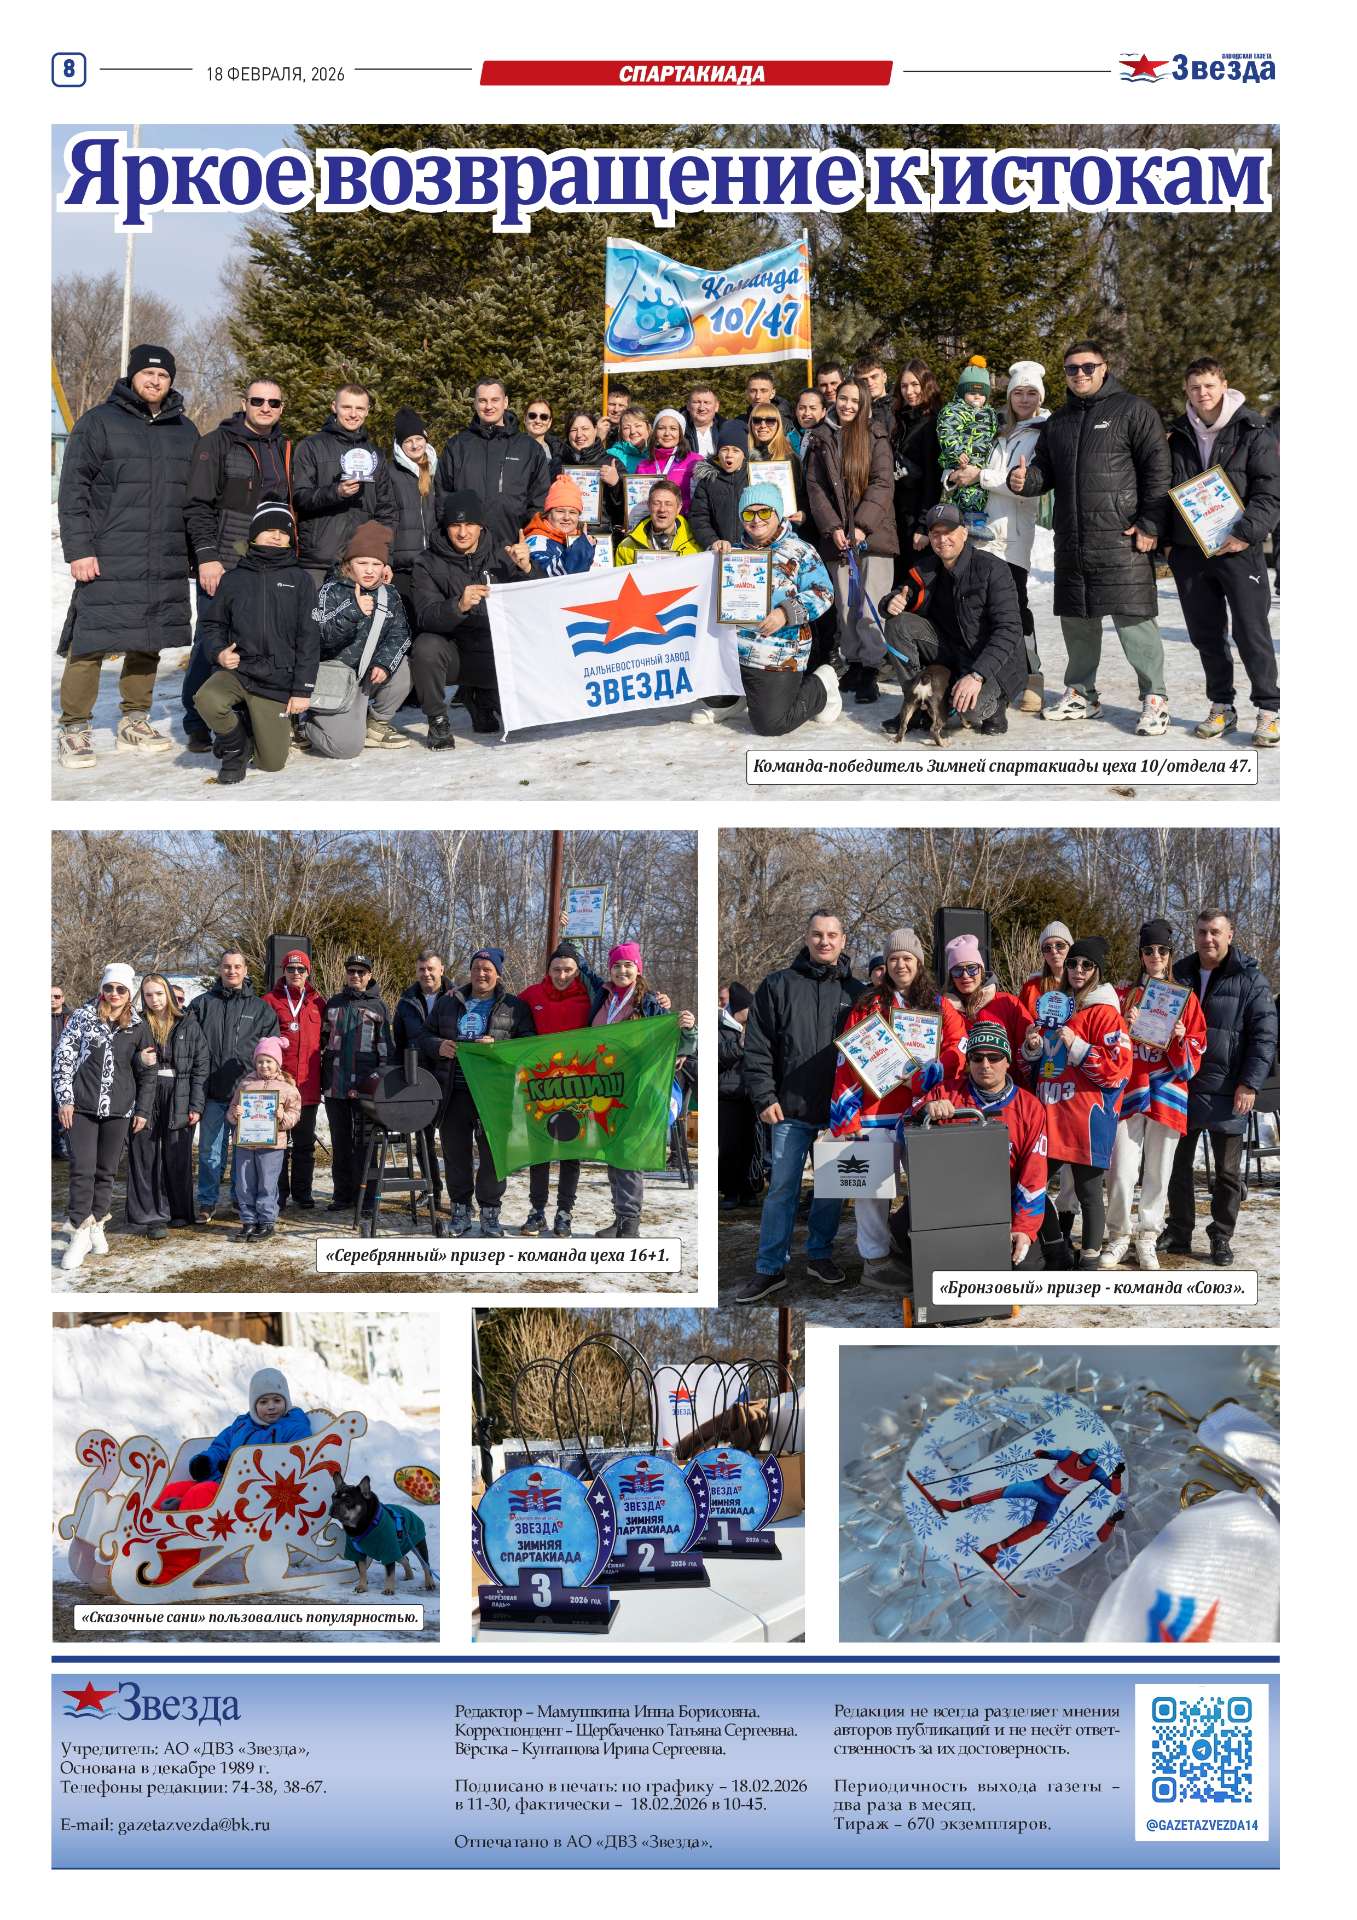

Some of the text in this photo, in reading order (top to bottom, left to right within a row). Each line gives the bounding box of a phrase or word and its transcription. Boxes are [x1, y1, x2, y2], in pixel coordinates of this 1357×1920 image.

[64, 59, 75, 77] 8
[208, 67, 344, 83] 18 ФЕВРАЛЯ, 2026
[620, 66, 765, 85] СПАРТАКИАДА
[1172, 54, 1276, 83] Звезда
[709, 298, 802, 337] 10/47
[584, 651, 690, 678] ДАЛЬНЕВОСТОЧНЫЙ ЗАВОД
[585, 666, 693, 708] ЗВЕЗДА
[527, 1072, 624, 1101] КИПИШ
[840, 1179, 867, 1187] ЗВЕЗДА
[711, 1486, 738, 1496] ВЕЗДА
[624, 1501, 662, 1512] ЗВЕЗДА
[710, 1507, 755, 1515] РТАКИАДА
[711, 1499, 740, 1507] ИМНЯЯ
[514, 1522, 560, 1535] ЗВЕЗДА
[625, 1515, 664, 1526] ЗИМНЯЯ
[616, 1524, 681, 1535] ПАРТАКИАДА
[717, 1521, 733, 1546] 1
[517, 1540, 562, 1551] ЗИМНЯЯ
[500, 1551, 582, 1564] СПАРТАКИАДА
[637, 1543, 656, 1573] 2
[531, 1573, 552, 1608] 3
[569, 1595, 589, 1604] 2026
[118, 1681, 242, 1726] Звезда
[456, 1705, 522, 1721] Редактор
[538, 1705, 630, 1721] Мамушкина
[635, 1705, 674, 1718] Инна
[679, 1705, 760, 1721] Борисовна.
[835, 1704, 1119, 1721] Редакция не всегда разделяет мнения
[456, 1723, 563, 1740] Корреспондент
[576, 1723, 664, 1740] Щербаченко
[667, 1723, 722, 1736] Татьяна
[725, 1723, 797, 1740] Сергеевна.
[834, 1722, 1120, 1741] авторов публикаций и не несёт ответ-
[61, 1741, 309, 1758] Учредитель: АО «ДВЗ «Звезда»,
[455, 1742, 507, 1759] Вёрстка
[604, 1742, 649, 1759] Ирина
[653, 1742, 726, 1759] Сергеевна.
[834, 1744, 1070, 1759] ственность за их достоверность.
[60, 1761, 269, 1777] Основана в декабре 1989 г.
[60, 1780, 326, 1797] Телефоны редакции: 74-38, 38-67.
[456, 1779, 544, 1794] Подписано
[549, 1783, 557, 1792] в
[561, 1783, 617, 1792] печать:
[623, 1783, 641, 1792] по
[647, 1779, 714, 1797] графику
[732, 1779, 807, 1793] 18.02.2026
[835, 1779, 967, 1796] Периодичность
[978, 1783, 1036, 1794] выхода
[1048, 1783, 1101, 1792] газеты
[456, 1802, 463, 1810] в
[468, 1798, 510, 1812] 11-30,
[515, 1797, 610, 1814] фактически
[631, 1797, 707, 1810] 18.02.2026
[712, 1802, 720, 1810] в
[724, 1797, 766, 1810] 10-45.
[833, 1802, 975, 1815] два раза в месяц.
[61, 1818, 269, 1835] E-mail: gazetazvezda@bk.ru
[834, 1817, 888, 1834] Тираж
[908, 1817, 934, 1830] 670
[941, 1821, 1051, 1834] экземпляров.
[1146, 1819, 1258, 1832] @GAZETAZVEZDA14
[455, 1835, 712, 1850] Отпечатано в АО «ДВЗ «Звезда».
